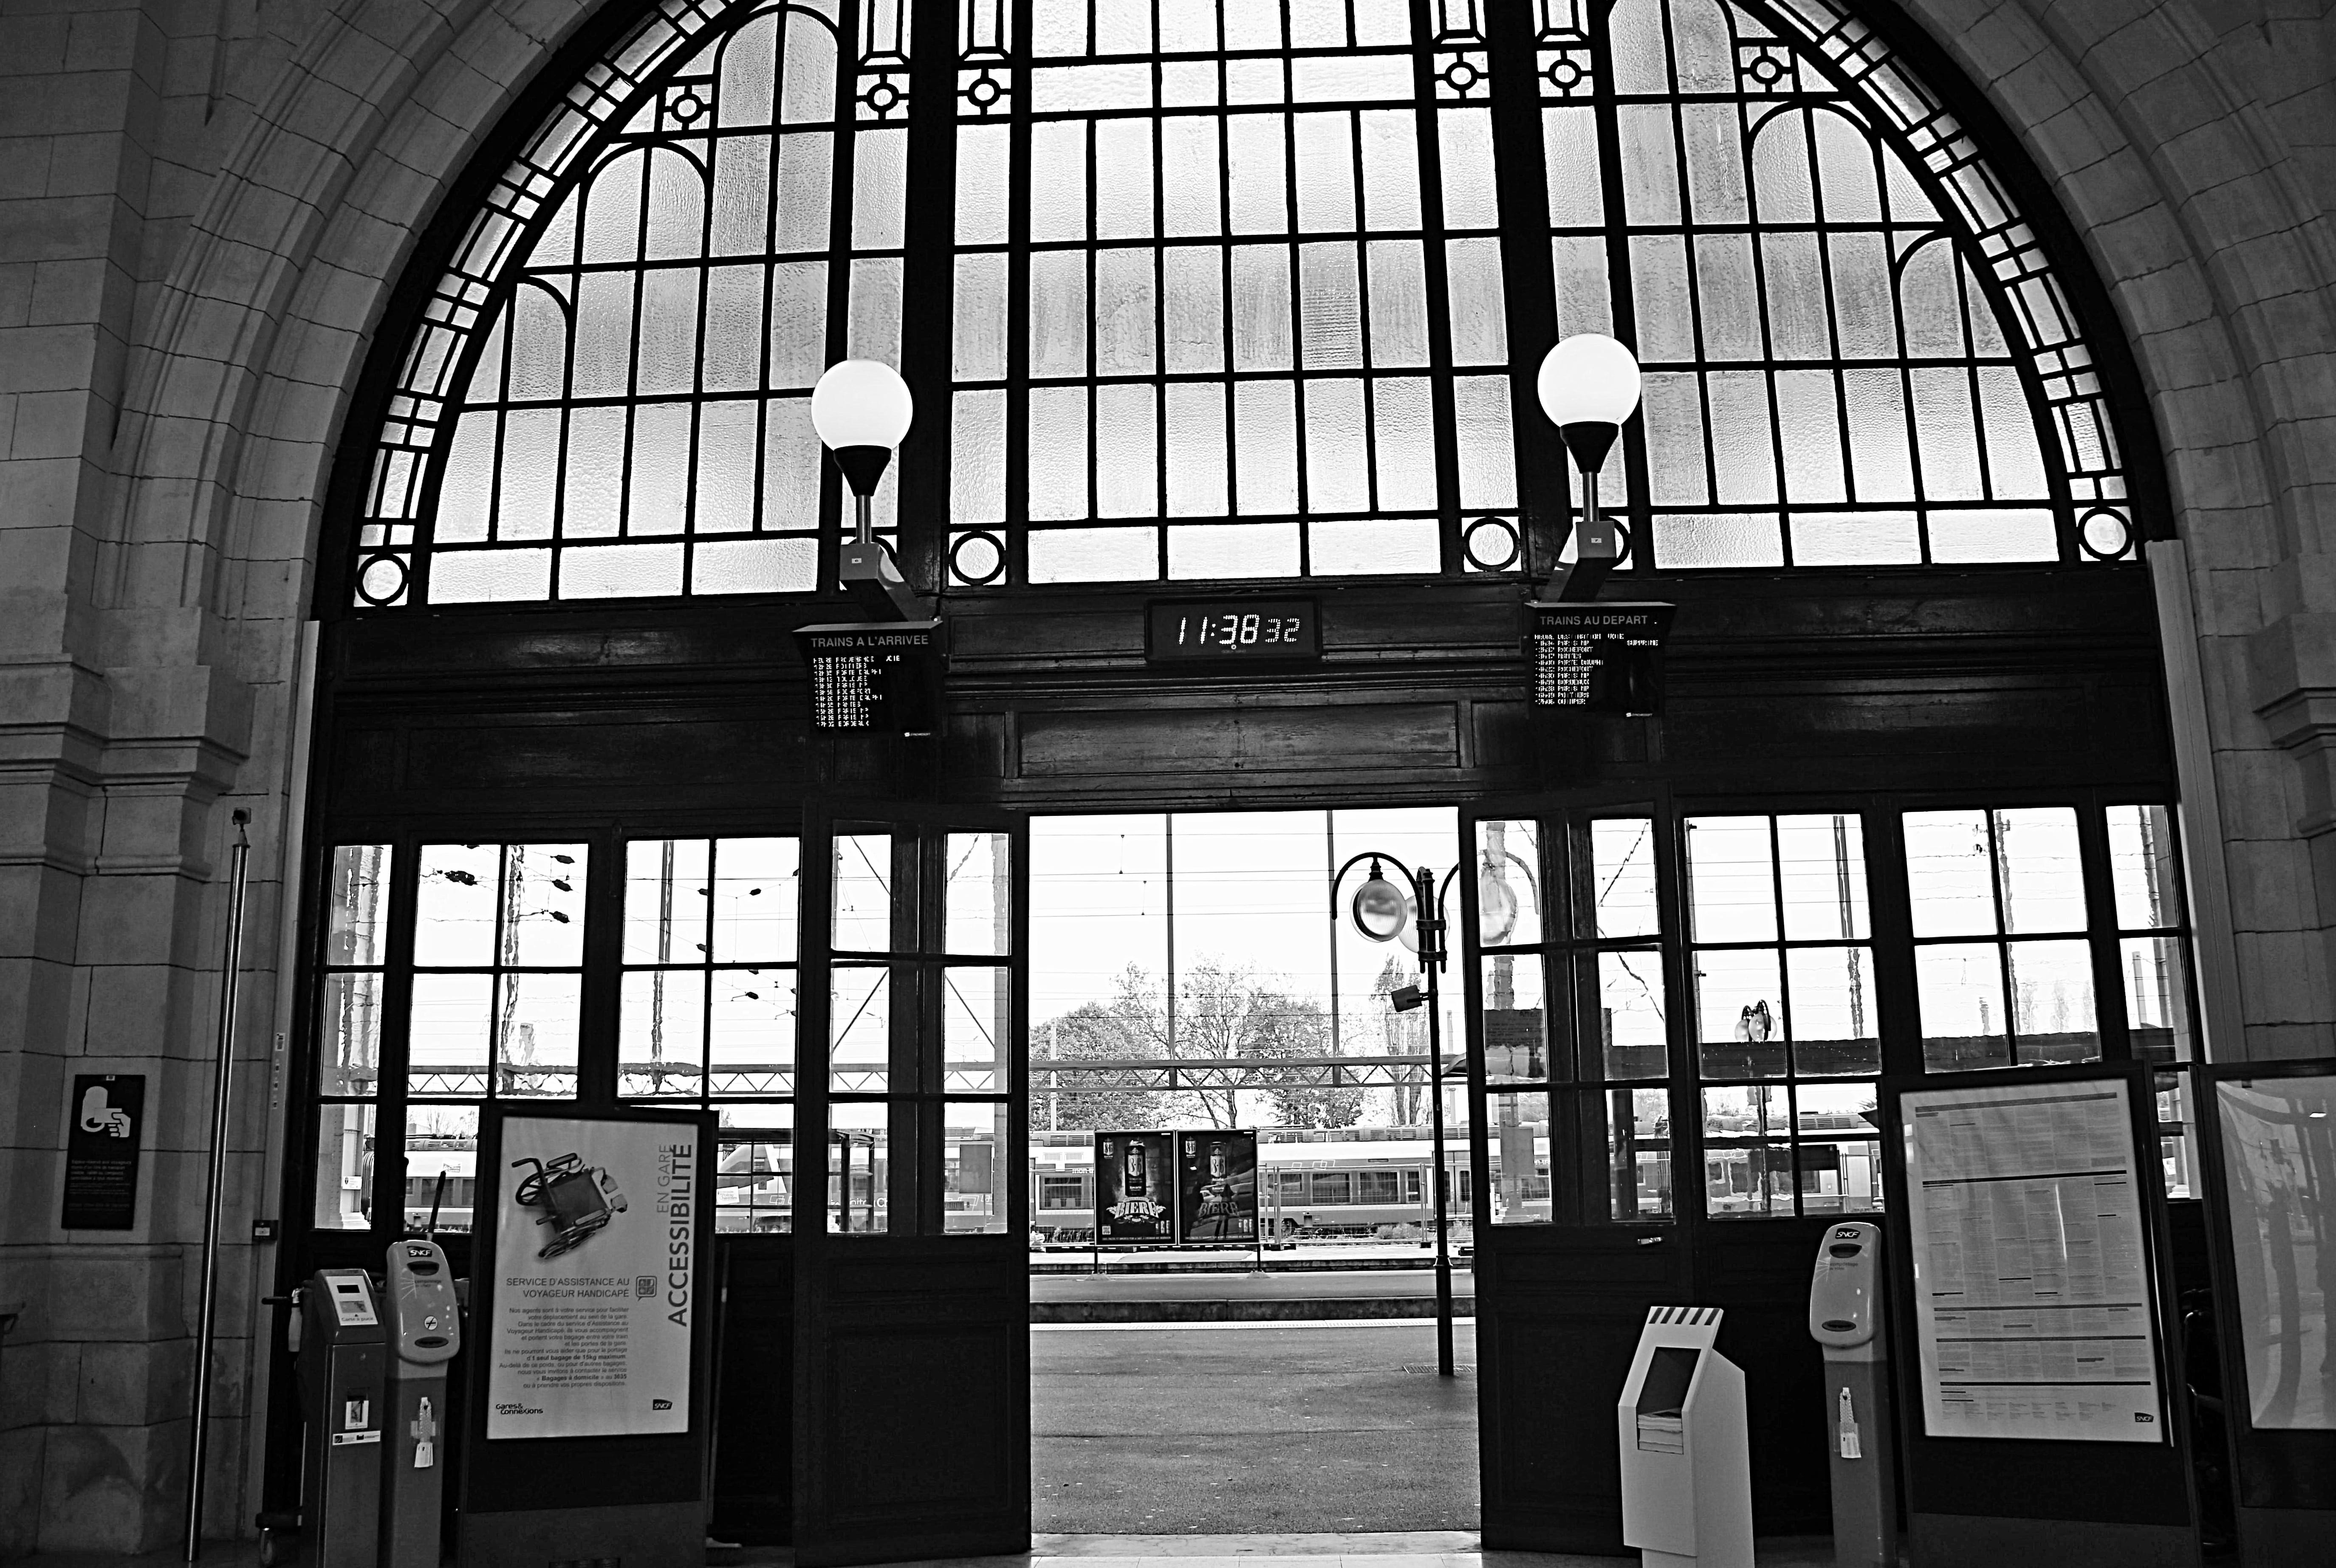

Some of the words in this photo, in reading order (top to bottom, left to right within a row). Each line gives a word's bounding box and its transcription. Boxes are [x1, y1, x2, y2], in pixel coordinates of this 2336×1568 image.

[1540, 616, 1581, 625] TRAINS
[1584, 616, 1599, 625] AU
[1603, 615, 1648, 624] DEPART
[1178, 614, 1260, 645] 11:38
[1265, 618, 1299, 642] 32
[811, 637, 853, 647] TRAINS
[857, 637, 864, 646] A
[868, 635, 929, 646] L'ARRIVEE
[658, 1145, 671, 1187] GARE
[657, 1192, 669, 1213] EN
[668, 1145, 692, 1327] ACCESSIBILITÉ
[506, 1278, 547, 1286] SERVICE
[523, 1289, 574, 1297] VOYAGEUR
[577, 1288, 629, 1297] HANDICAPÉ
